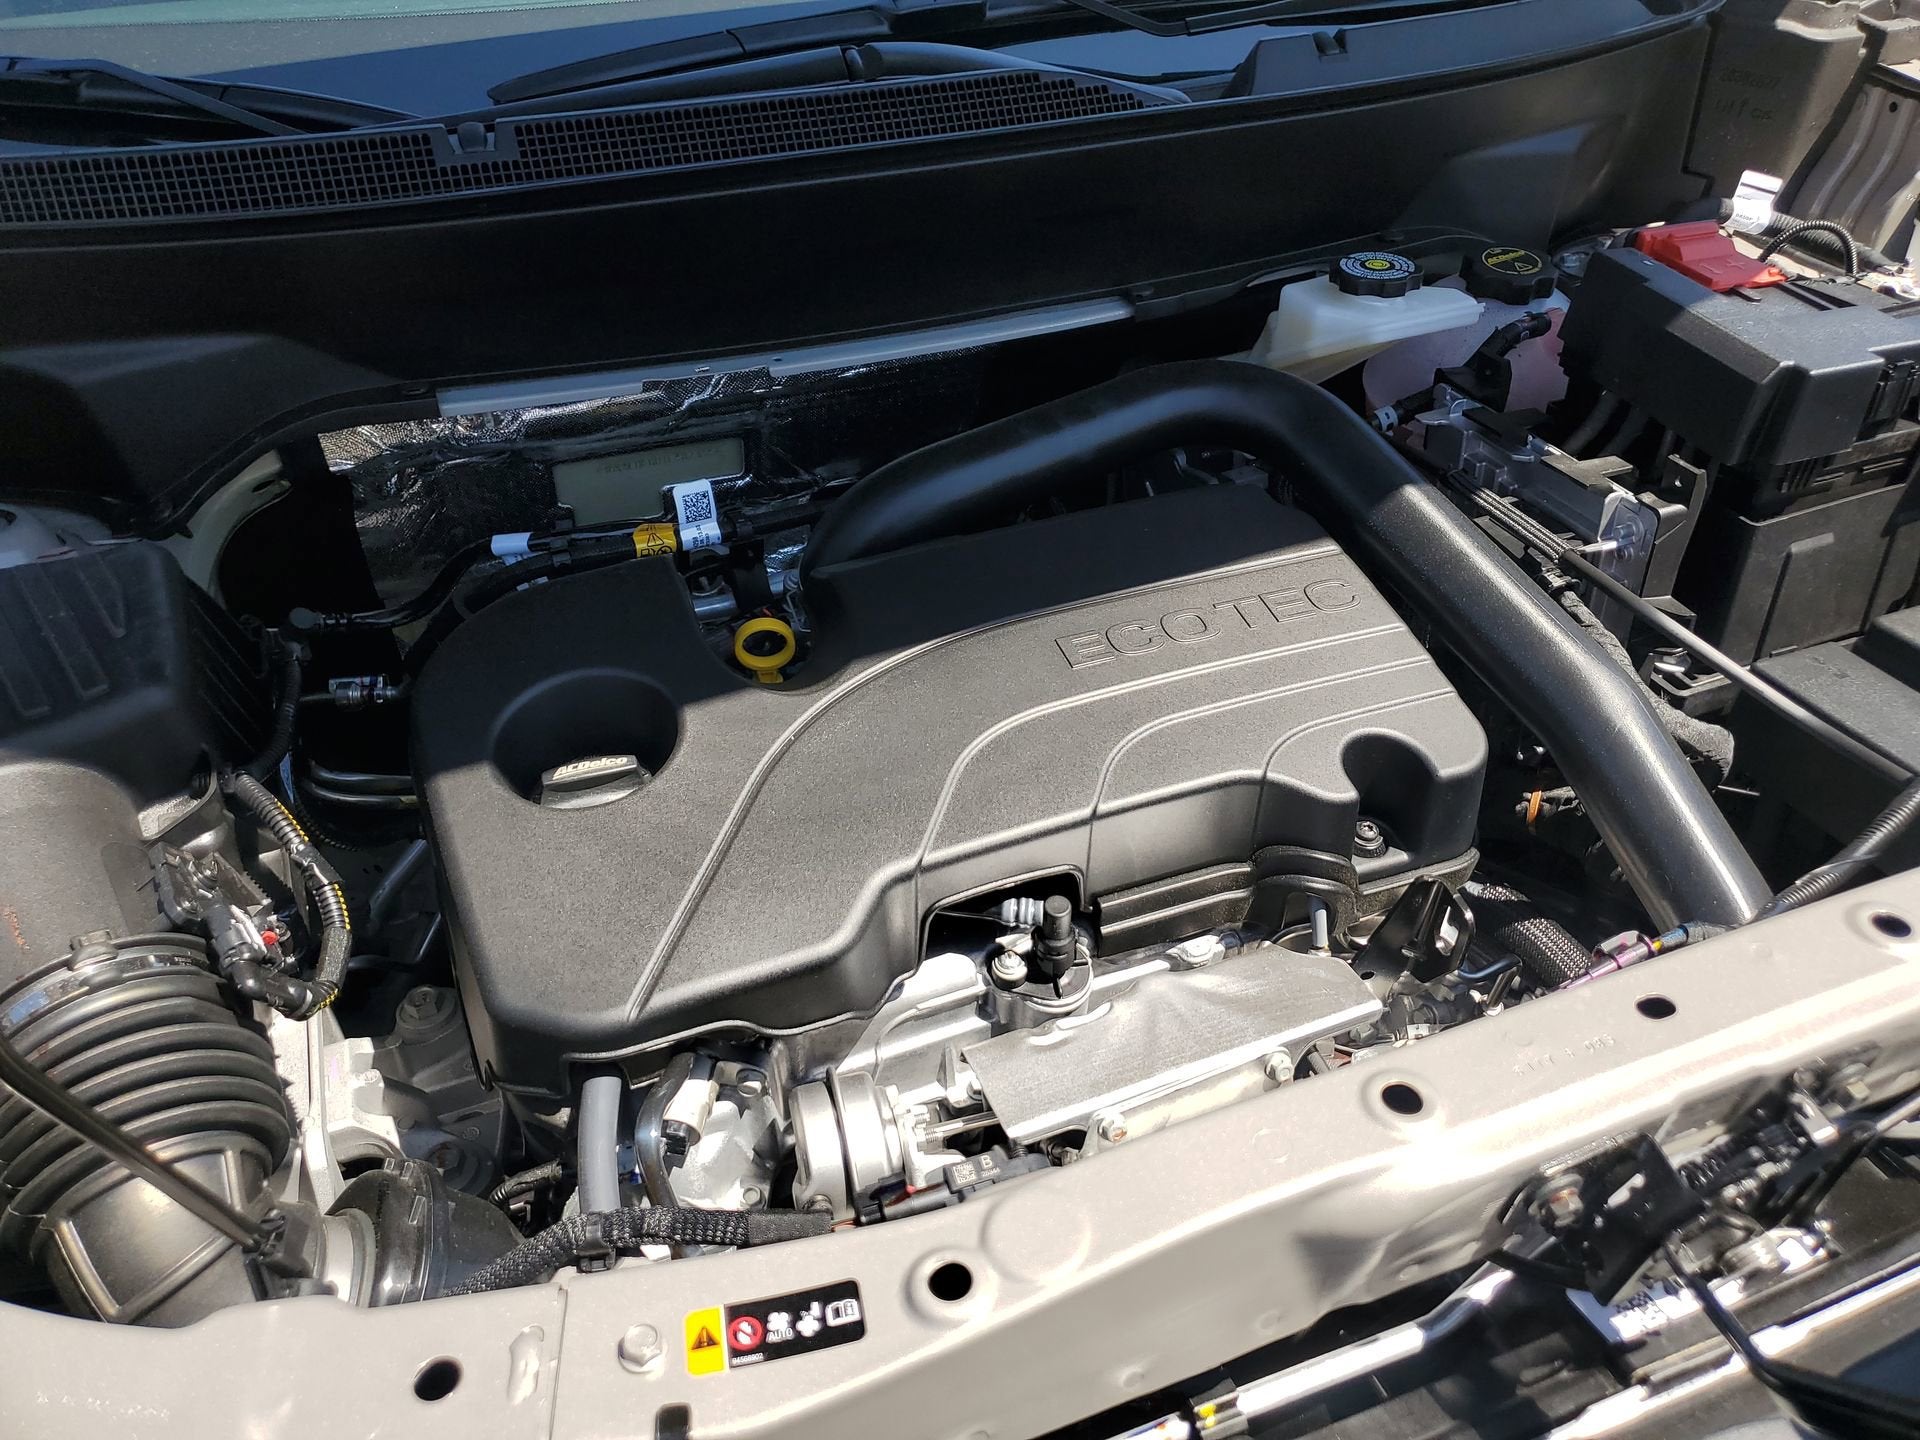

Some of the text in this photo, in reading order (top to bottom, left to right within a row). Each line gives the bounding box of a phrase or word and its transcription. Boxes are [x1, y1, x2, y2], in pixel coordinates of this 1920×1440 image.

[1055, 579, 1361, 668] ECOTEC
[553, 757, 628, 779] ACDelco
[981, 1155, 993, 1168] B
[768, 1329, 793, 1341] AUTO
